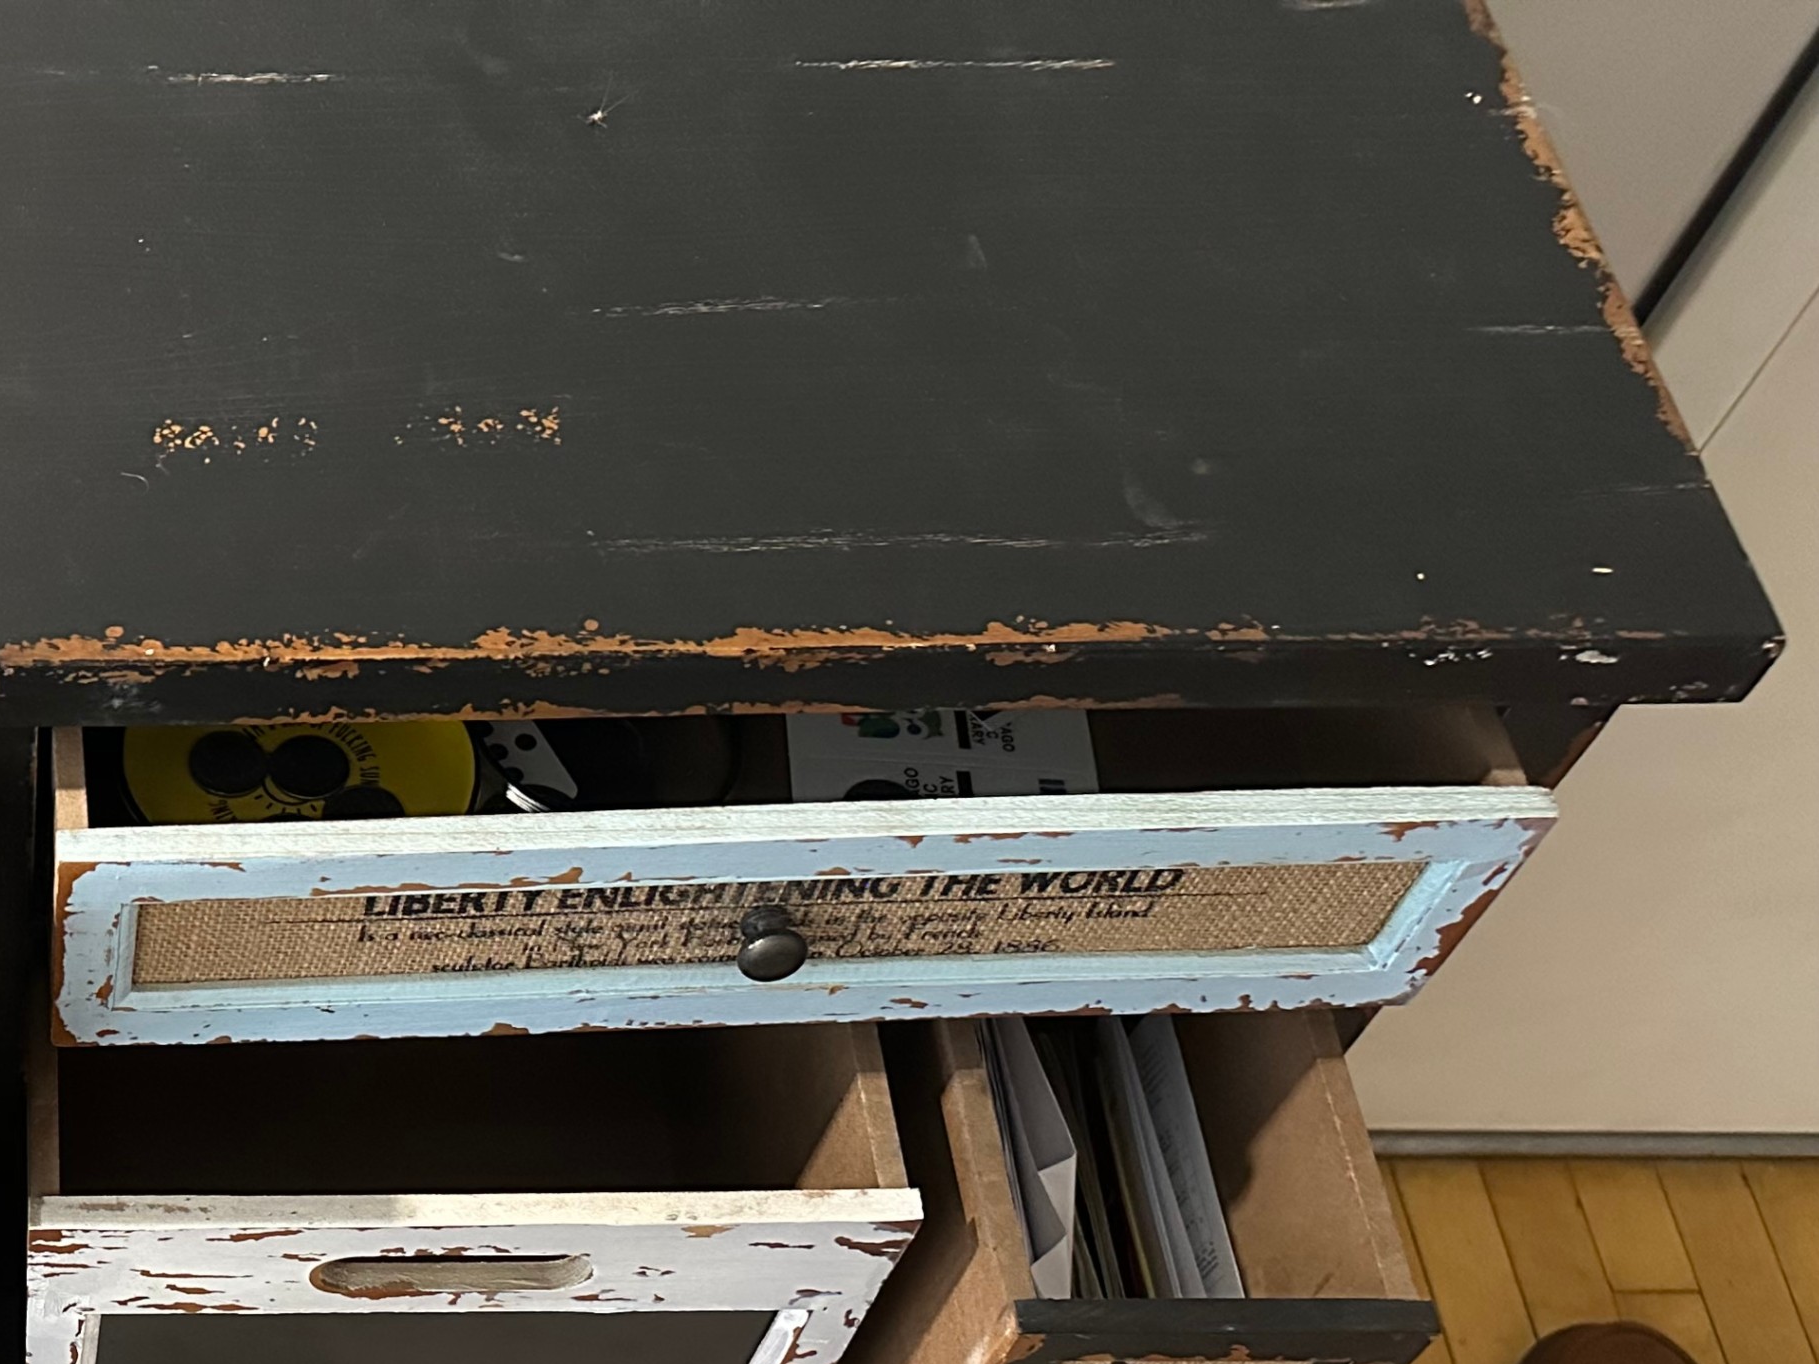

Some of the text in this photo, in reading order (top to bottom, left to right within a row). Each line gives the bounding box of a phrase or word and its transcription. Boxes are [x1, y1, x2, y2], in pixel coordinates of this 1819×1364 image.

[364, 888, 545, 916] LIBERTY
[920, 872, 1002, 897] THE
[1020, 868, 1185, 894] WORLD
